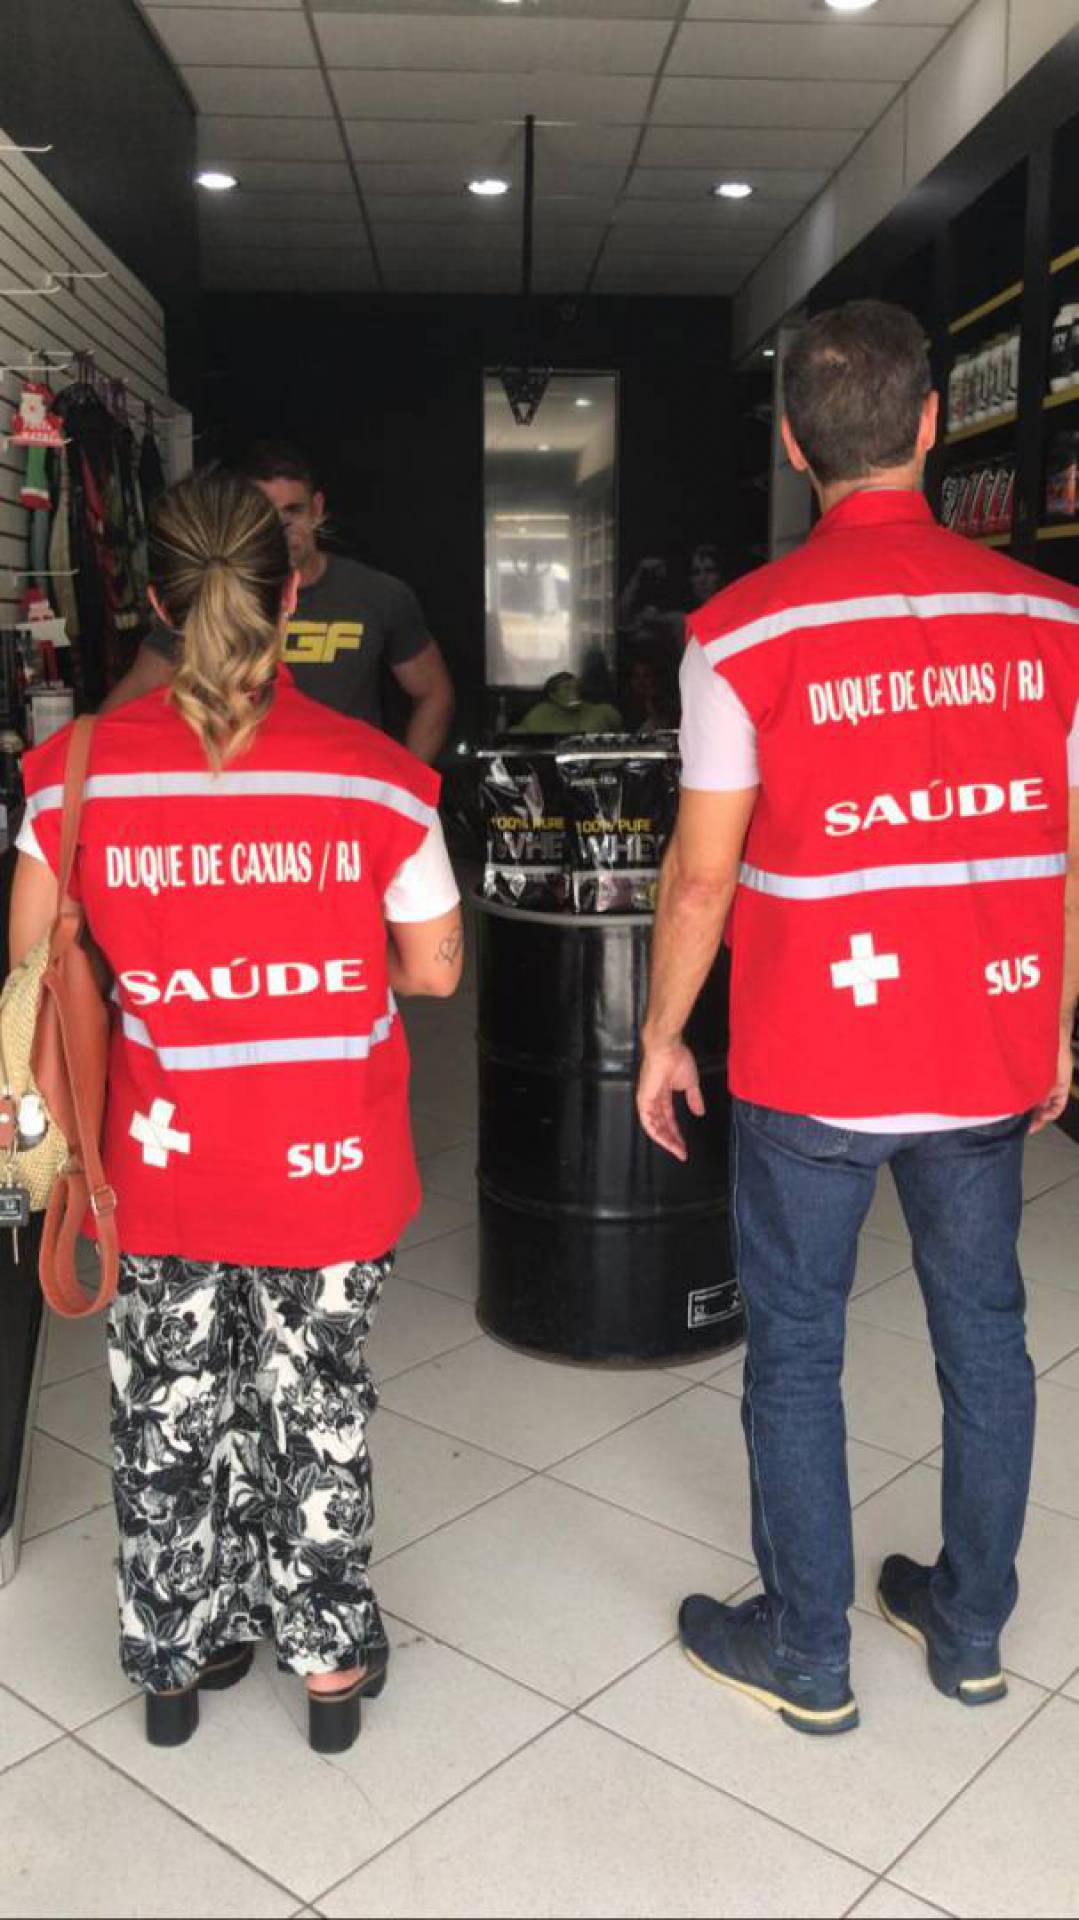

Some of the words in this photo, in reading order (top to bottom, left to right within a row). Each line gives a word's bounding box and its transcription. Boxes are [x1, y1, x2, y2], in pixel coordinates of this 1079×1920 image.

[808, 672, 884, 727] DUQUE
[888, 669, 920, 713] DE
[922, 661, 997, 708] CAXIAS
[1002, 661, 1011, 712] /
[1017, 659, 1045, 702] RJ
[824, 777, 1048, 837] SAÚDE
[106, 844, 184, 897] DUQUE
[191, 843, 225, 887] DE
[230, 840, 313, 886] CAXIAS
[318, 842, 331, 891] /
[335, 840, 362, 883] RJ
[119, 957, 368, 1006] SAÚDE
[984, 954, 1041, 996] SUS
[287, 1135, 364, 1179] SUS
